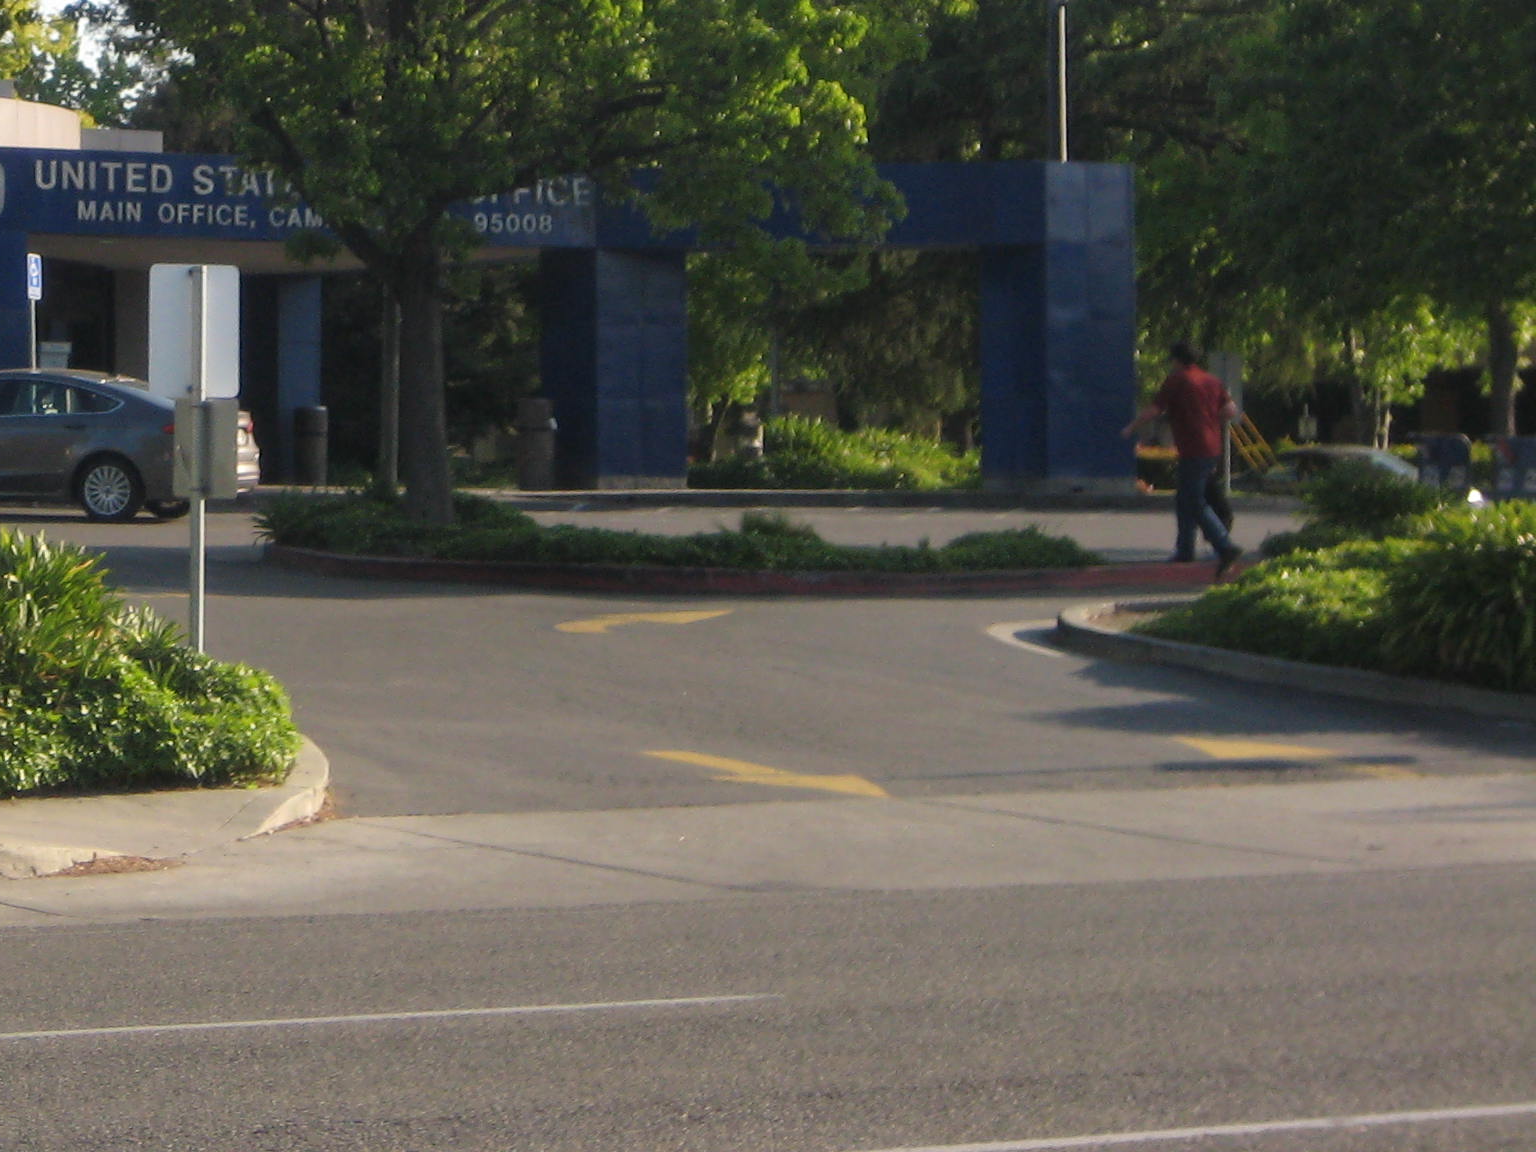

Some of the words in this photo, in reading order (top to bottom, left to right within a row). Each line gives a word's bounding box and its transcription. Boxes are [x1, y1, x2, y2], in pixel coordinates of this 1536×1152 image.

[35, 159, 173, 194] UNITED
[192, 164, 302, 197] STAT
[77, 200, 141, 224] MAIN
[158, 202, 256, 229] OFFICE,
[474, 209, 553, 234] 95008
